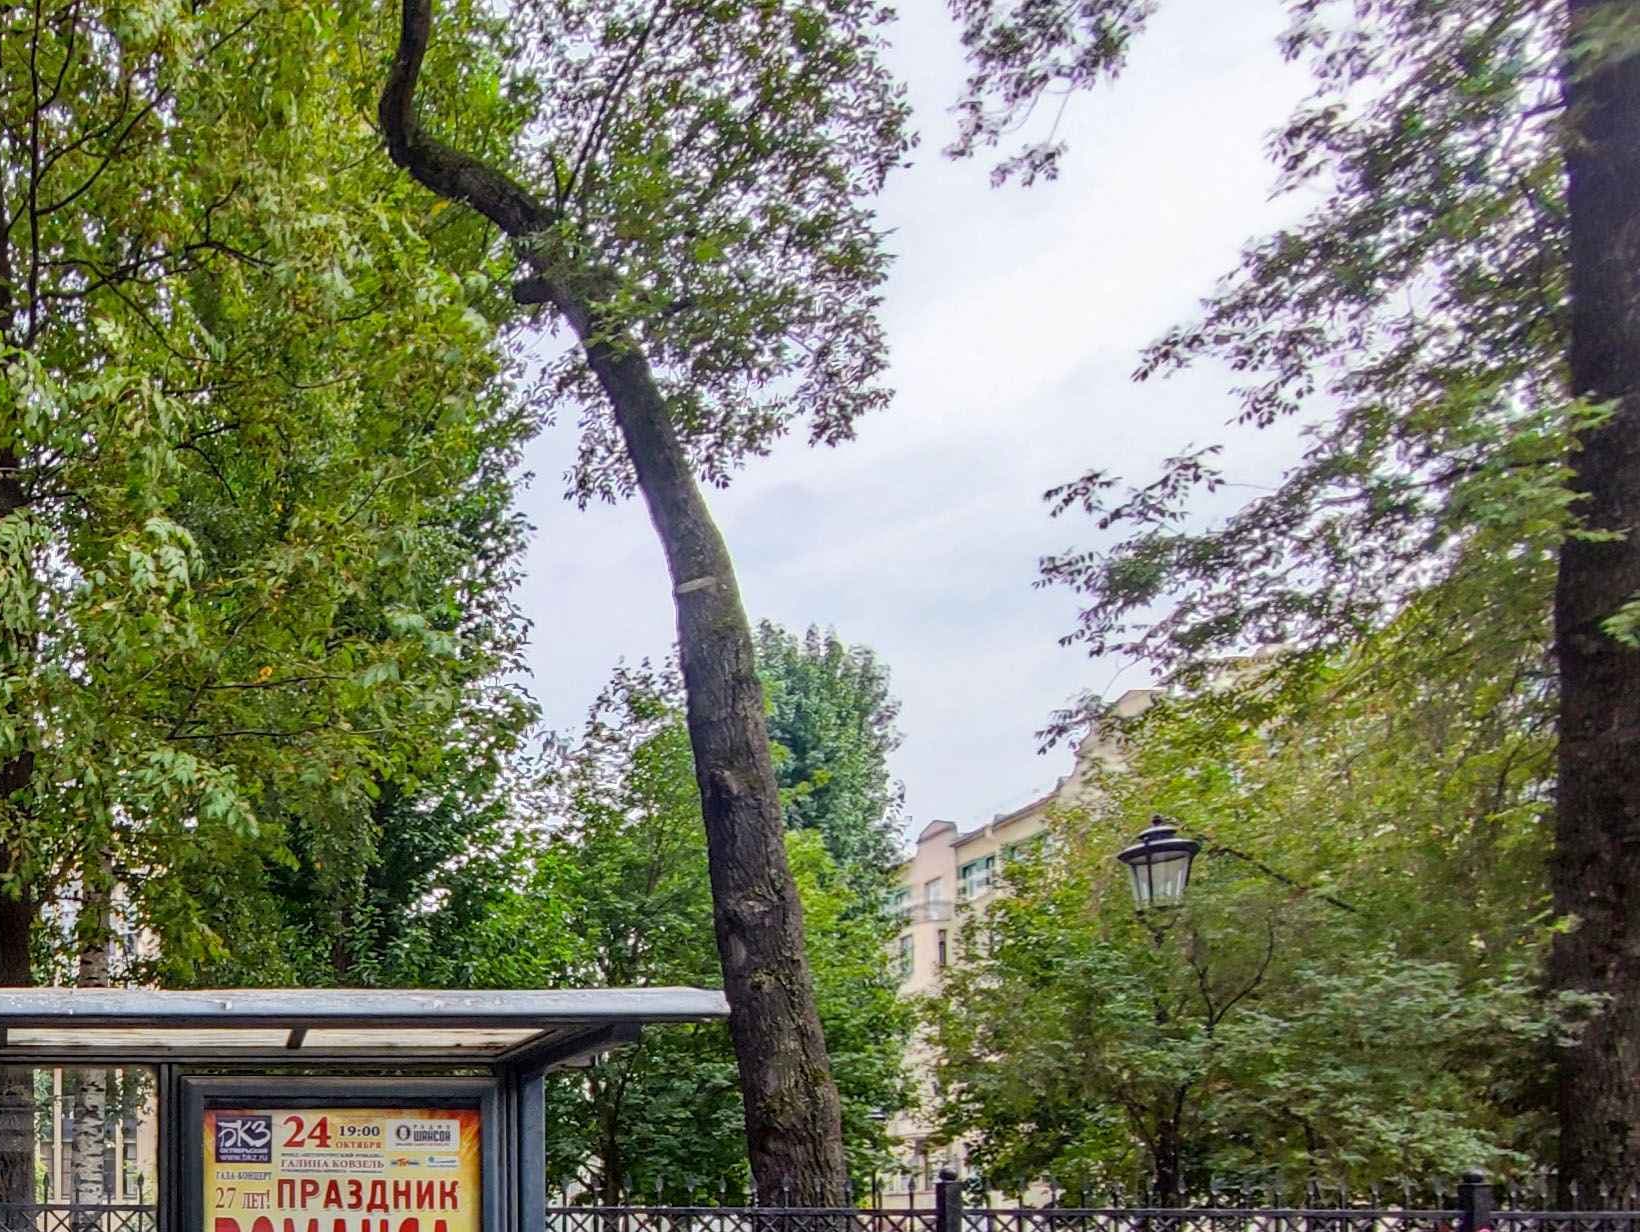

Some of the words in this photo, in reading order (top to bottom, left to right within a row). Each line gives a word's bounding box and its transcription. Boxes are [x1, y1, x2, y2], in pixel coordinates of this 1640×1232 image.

[283, 1115, 331, 1148] 24
[338, 1126, 380, 1137] 19:00
[280, 1159, 329, 1168] ГАЛИНА
[332, 1159, 385, 1168] КОВЗЕЛЬ
[216, 1187, 236, 1208] 27
[242, 1191, 270, 1209] ЛЕТ!
[277, 1179, 459, 1213] ПРАЗДНИК
